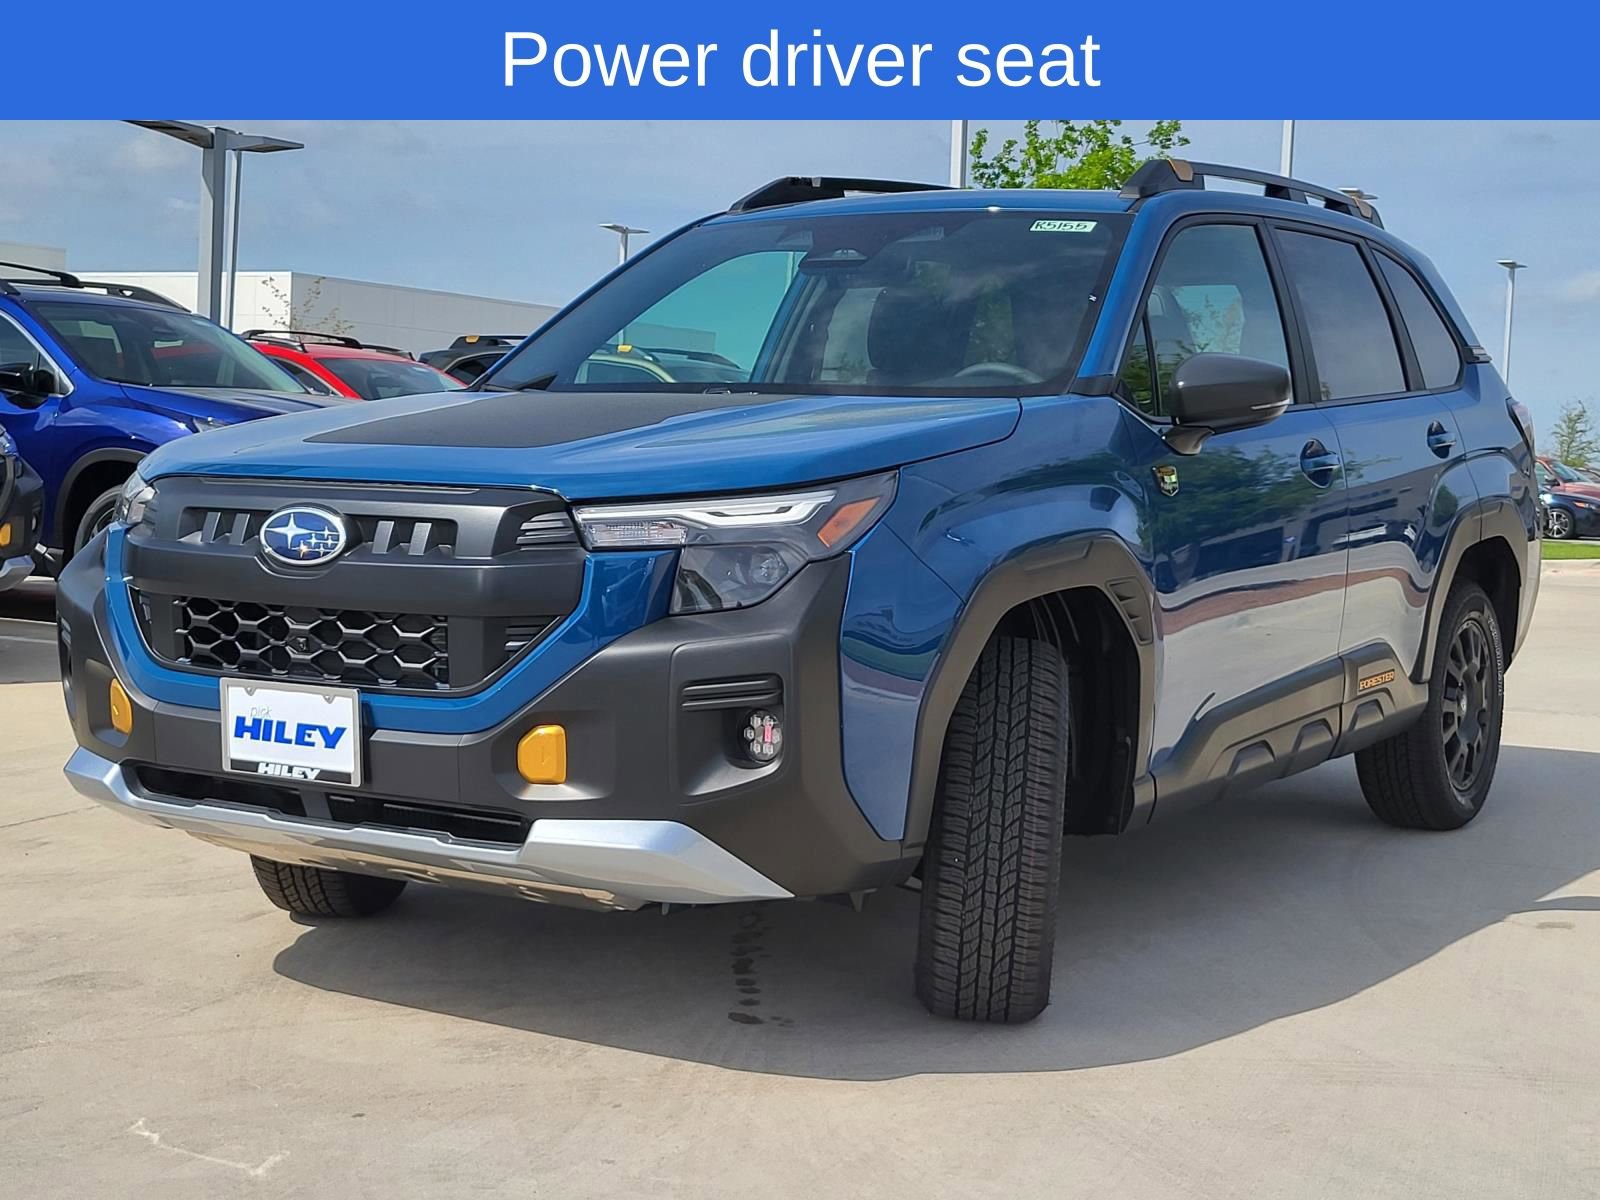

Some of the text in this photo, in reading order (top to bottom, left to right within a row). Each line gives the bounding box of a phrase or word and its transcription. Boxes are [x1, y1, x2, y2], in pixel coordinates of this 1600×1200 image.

[1359, 671, 1395, 690] FORESTER
[234, 715, 347, 749] HILEY
[257, 762, 321, 780] HILEY
